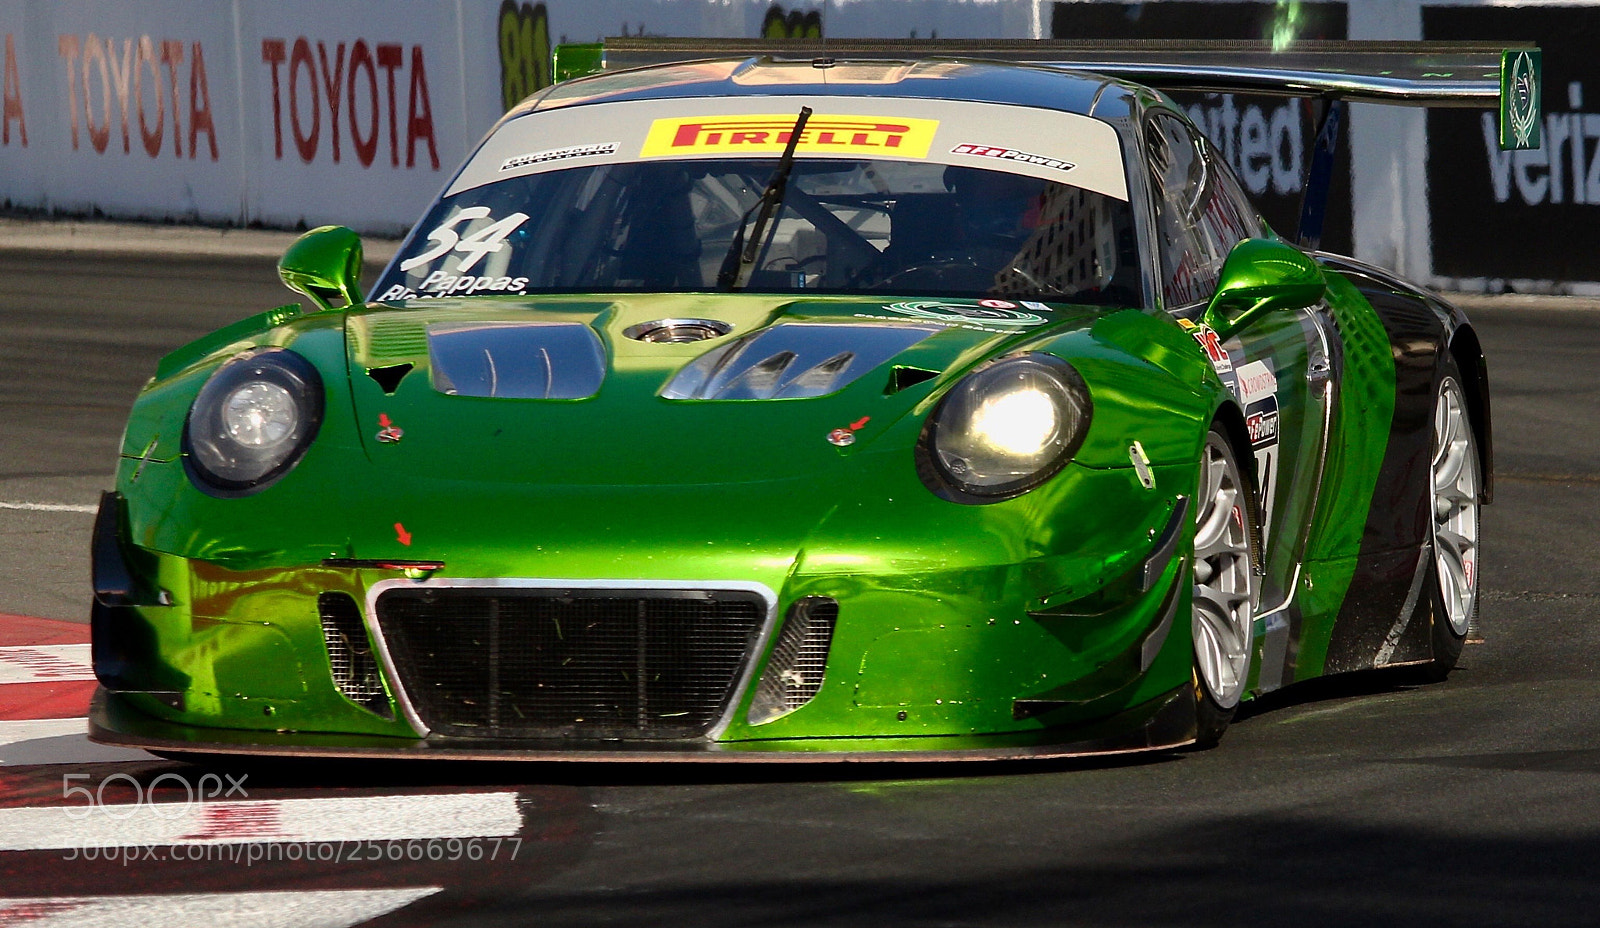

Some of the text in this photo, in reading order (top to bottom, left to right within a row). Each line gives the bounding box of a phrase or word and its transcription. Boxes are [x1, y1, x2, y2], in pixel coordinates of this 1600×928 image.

[58, 33, 219, 162] TOYOTA
[261, 37, 440, 171] TOYOTA
[671, 121, 910, 148] PIRELLI
[1187, 92, 1303, 196] ited
[401, 206, 530, 272] 54
